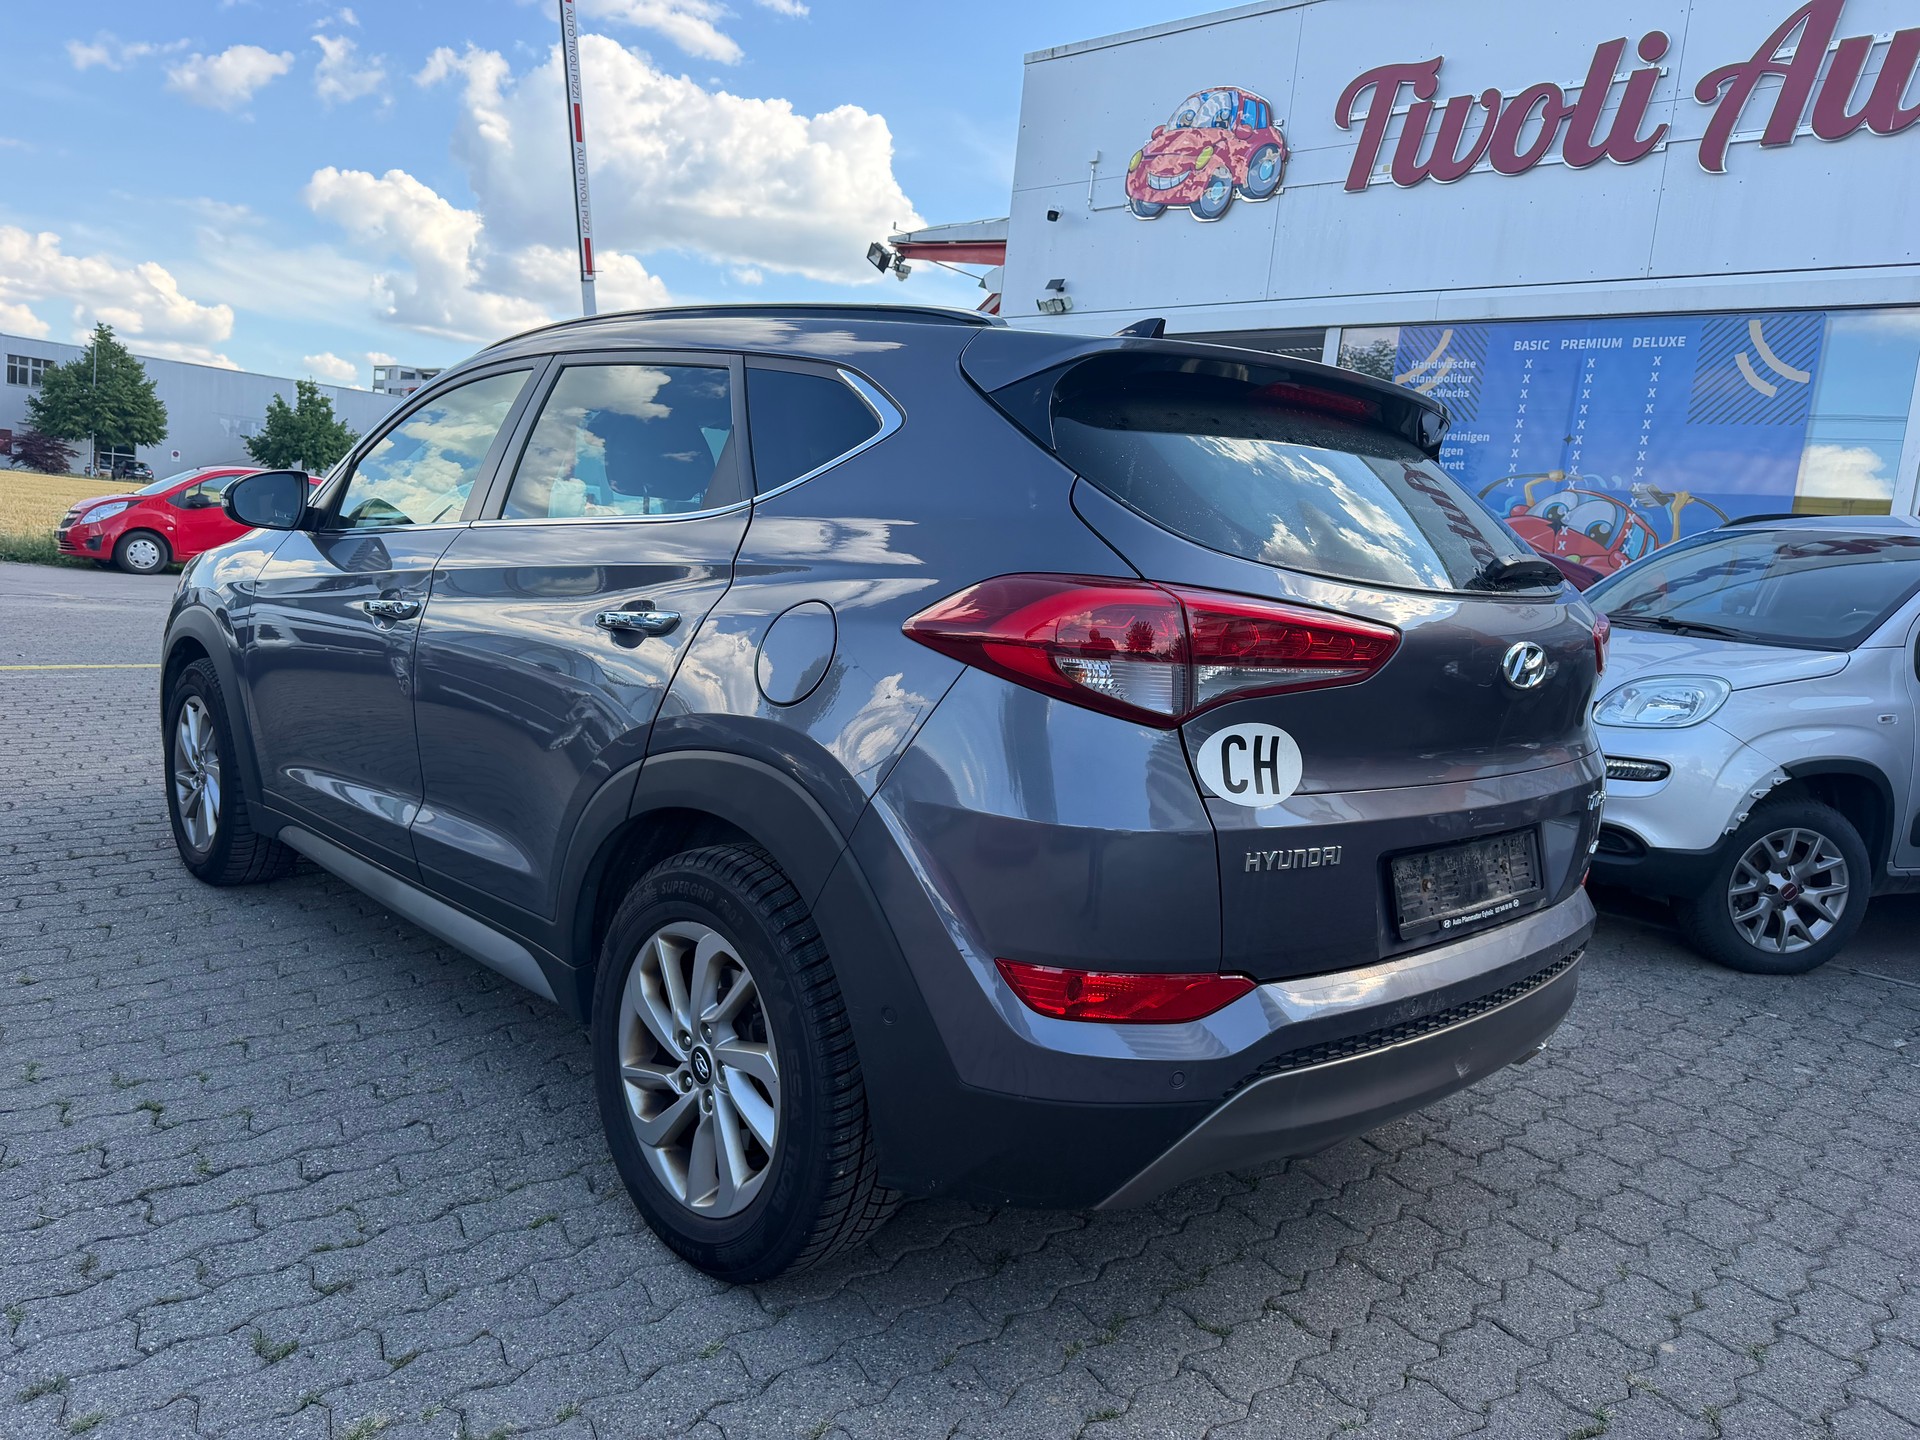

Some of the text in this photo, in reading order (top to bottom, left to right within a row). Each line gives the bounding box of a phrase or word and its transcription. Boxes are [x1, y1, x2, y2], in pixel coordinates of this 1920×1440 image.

[566, 7, 580, 99] AUTO TIVOLI PIZZI
[1334, 0, 1920, 193] Tivoli Au
[576, 147, 590, 234] AUTO TIVOLI PIZZI
[1513, 336, 1687, 351] BASIC PREMIUM DELUXE
[1524, 359, 1533, 369] X
[1586, 358, 1596, 368] X
[1652, 356, 1662, 366] X
[1409, 372, 1659, 384] Glanzpolitur X X X
[1421, 388, 1656, 399] no-Wachs X X X
[1517, 404, 1654, 414] X X X
[1515, 418, 1651, 430] X X X
[1513, 434, 1522, 444] X
[1574, 435, 1583, 445] X
[1639, 435, 1648, 445] X
[1440, 447, 1646, 461] ugen X X X
[1440, 460, 1644, 476] brett X X X
[1506, 478, 1514, 488] X
[1566, 480, 1576, 490] X
[1559, 526, 1568, 536] X
[1557, 540, 1566, 550] X
[1220, 734, 1280, 794] CH
[1244, 846, 1342, 872] HYUNDAI
[660, 880, 714, 902] SUPERGRIP
